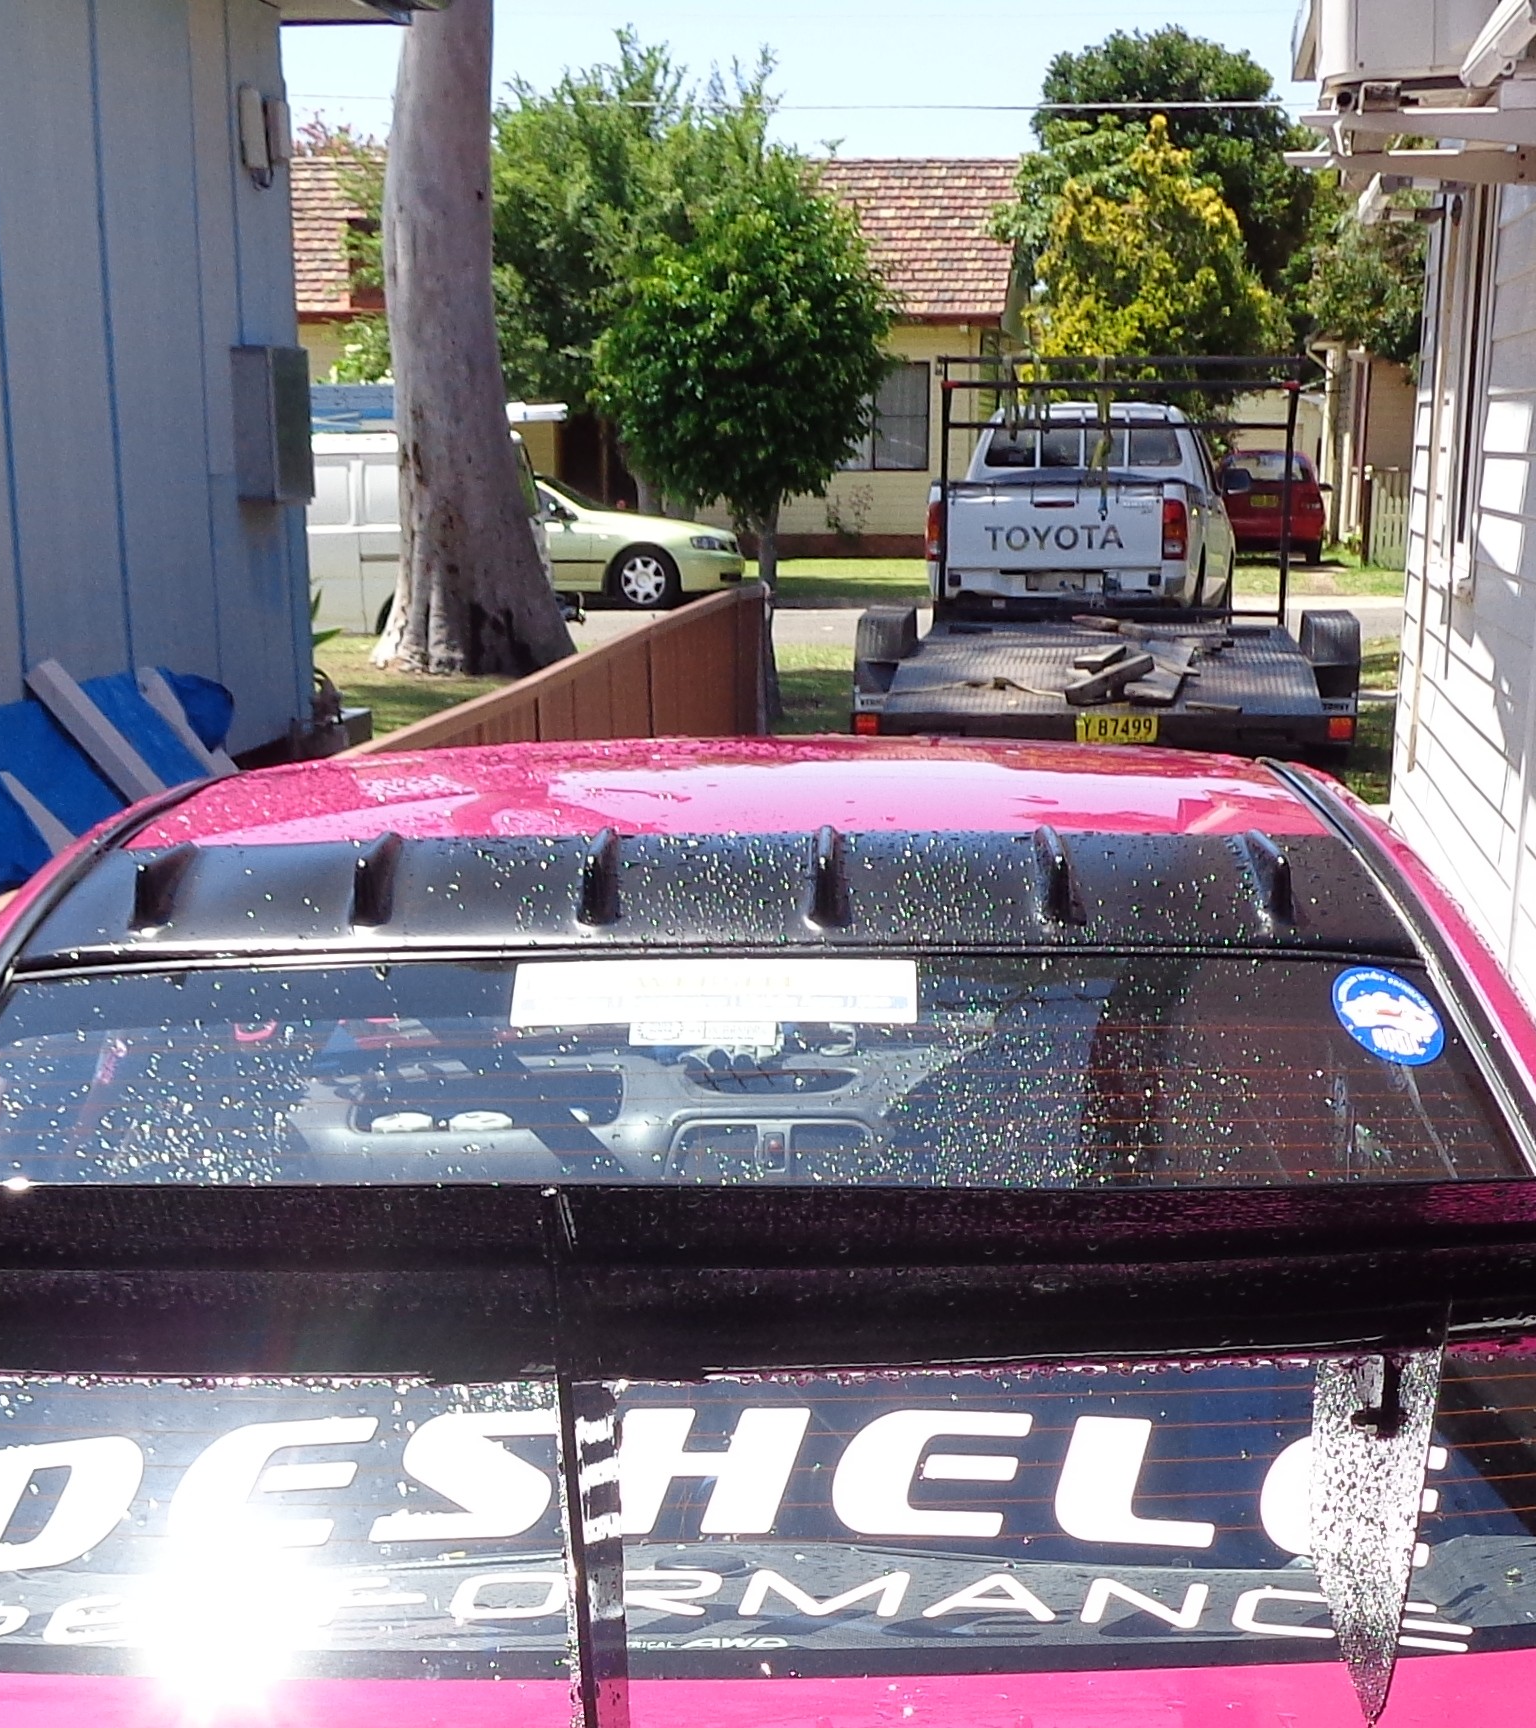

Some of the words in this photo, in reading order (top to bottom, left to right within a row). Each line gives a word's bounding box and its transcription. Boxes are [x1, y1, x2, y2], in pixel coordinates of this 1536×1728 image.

[984, 525, 1124, 551] TOYOTA
[1098, 718, 1153, 736] 87499
[680, 1637, 789, 1649] AWD
